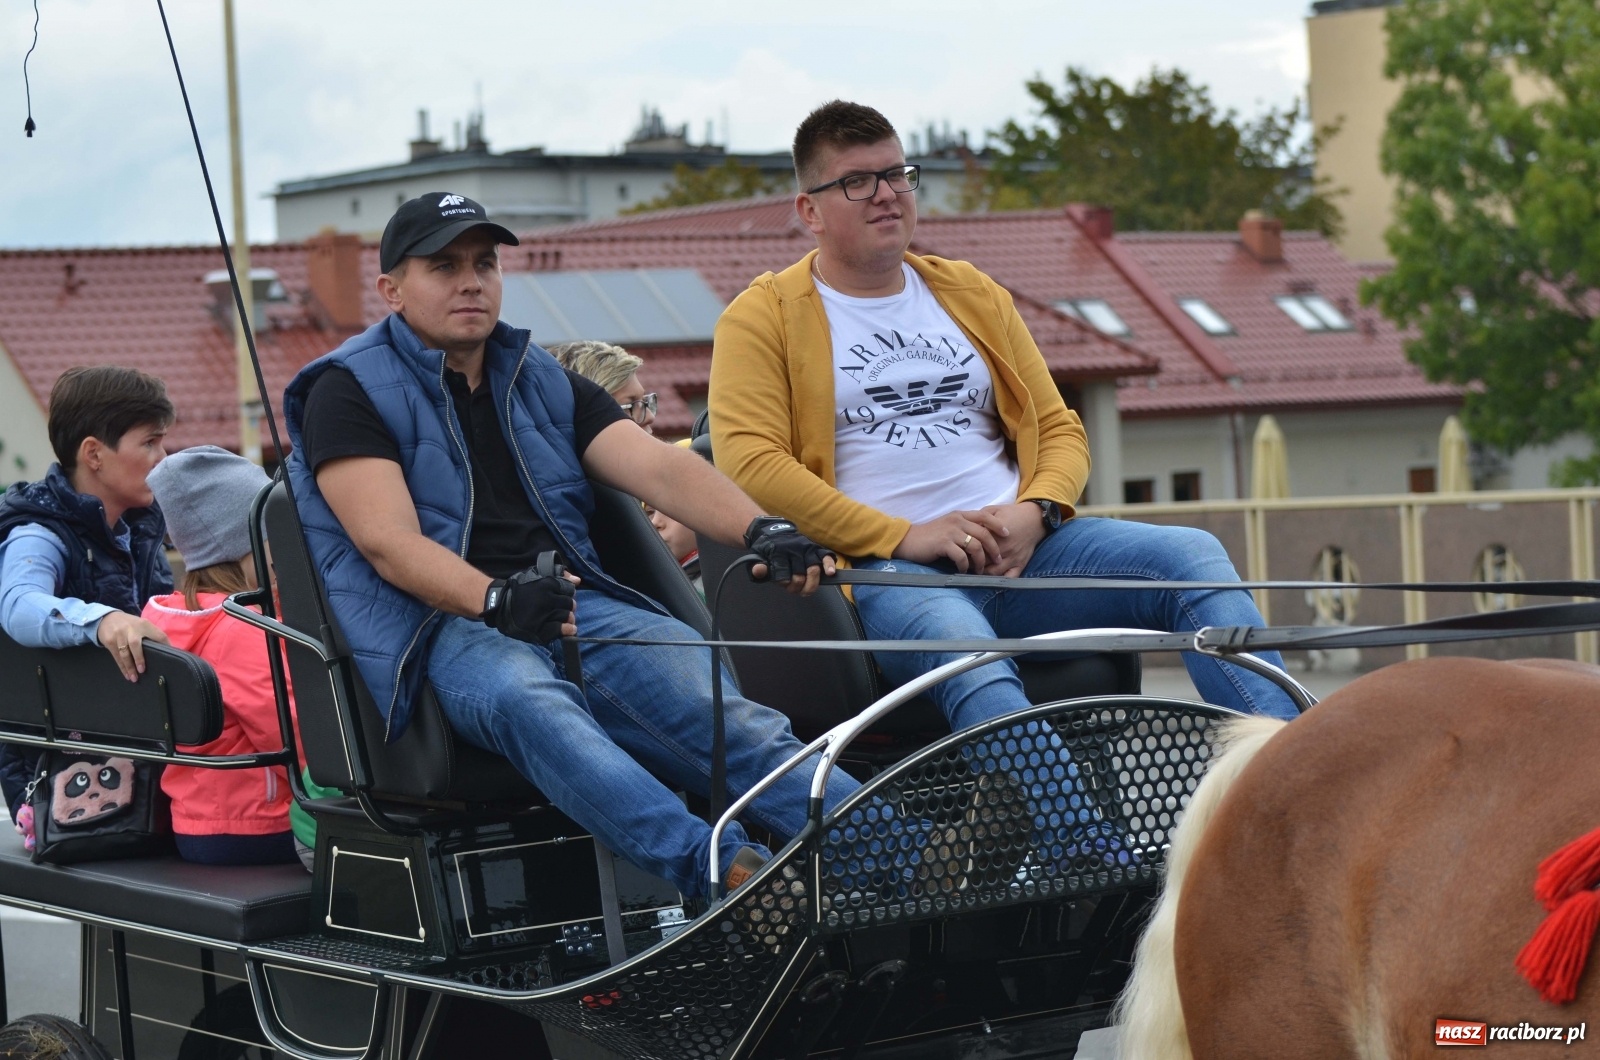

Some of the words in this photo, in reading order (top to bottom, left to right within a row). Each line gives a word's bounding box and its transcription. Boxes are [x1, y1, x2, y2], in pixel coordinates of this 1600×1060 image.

[441, 208, 476, 216] SPORTSWEAR
[838, 328, 977, 384] ARMANI
[868, 352, 905, 382] ORIGINAL
[906, 350, 959, 371] GARMENT
[862, 409, 972, 450] JEANS
